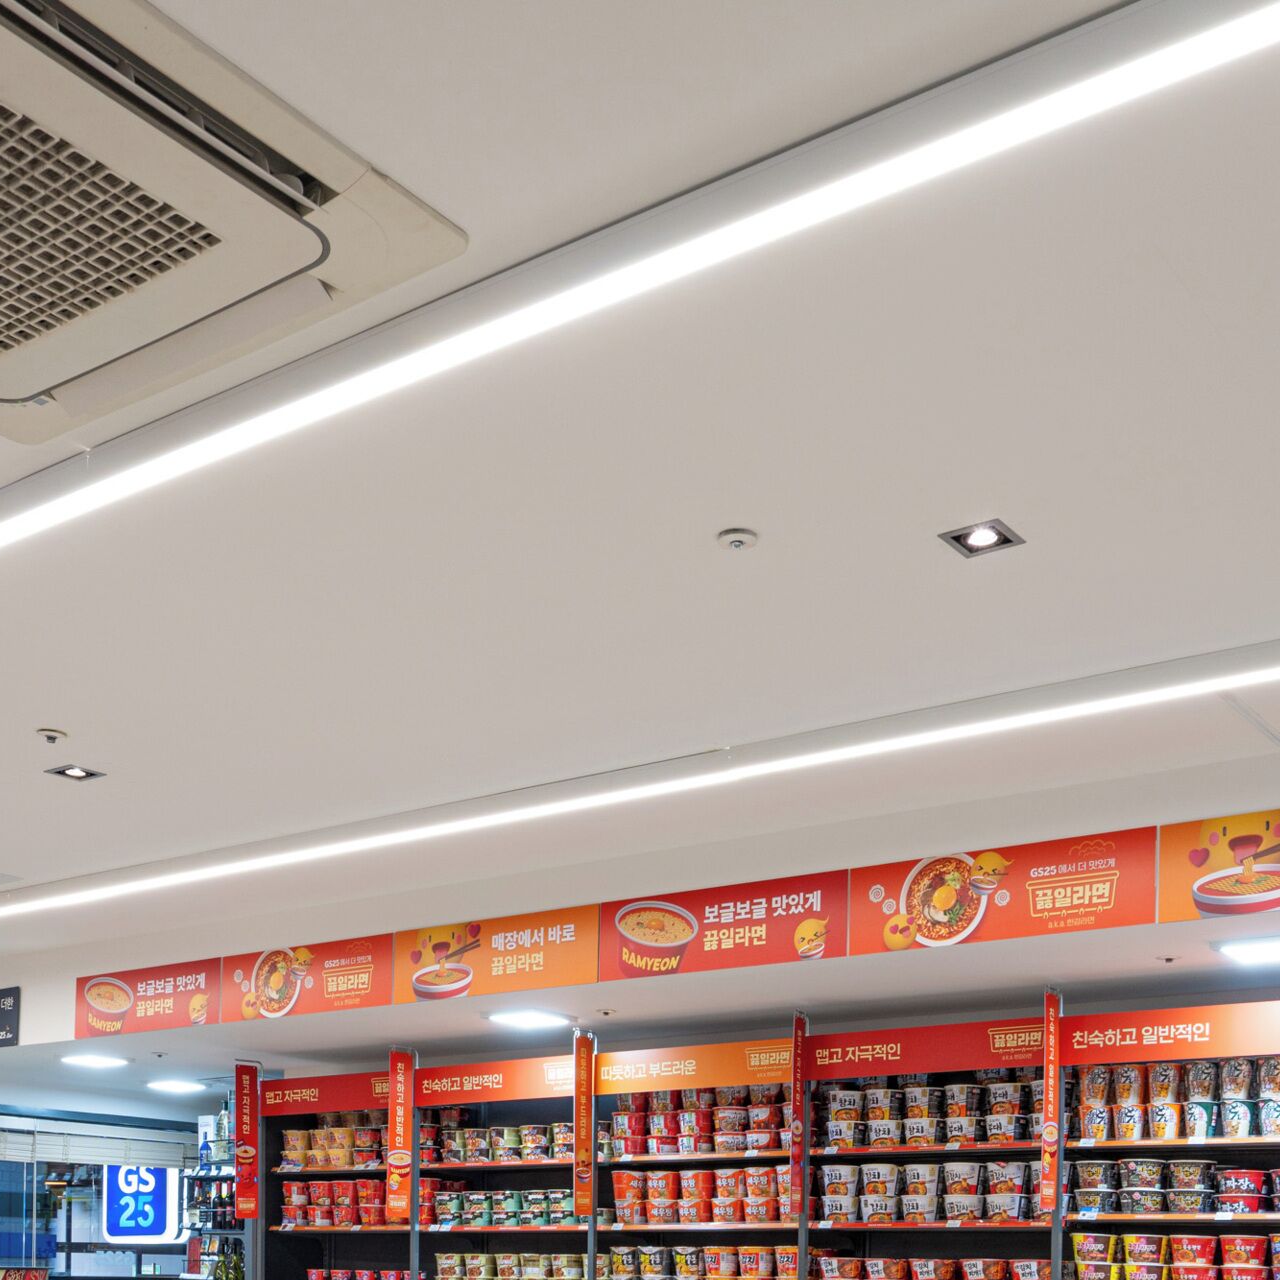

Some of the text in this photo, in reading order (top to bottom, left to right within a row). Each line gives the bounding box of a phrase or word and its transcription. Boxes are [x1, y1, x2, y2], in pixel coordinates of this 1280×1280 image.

[1030, 857, 1115, 878] GS25 에서 더 맛있게
[1036, 881, 1110, 910] 끓일라면
[704, 890, 821, 925] 보글보글 맛있게
[491, 924, 575, 953] 매장에서 바로
[704, 925, 766, 951] 끓일라면
[325, 959, 339, 968] GS25
[491, 953, 543, 975] 끓일라면
[622, 947, 680, 972] RAMYEON
[137, 973, 205, 996] 보글보글 맛있게
[327, 974, 368, 991] 끓일라면
[136, 998, 173, 1017] 끓일라면
[88, 1012, 121, 1032] RAMYEON
[994, 1031, 1042, 1047] 끓일라면
[1072, 1022, 1210, 1048] 친숙하고 일반적인
[750, 1051, 790, 1065] 끓일라면
[815, 1044, 901, 1065] 맵고 자극적인
[601, 1060, 696, 1080] 따뜻하고 부드러운
[422, 1074, 502, 1093] 친숙하고 일반적인
[266, 1088, 318, 1104] 맵고 자극적인
[118, 1166, 156, 1193] GS
[119, 1196, 155, 1228] 25
